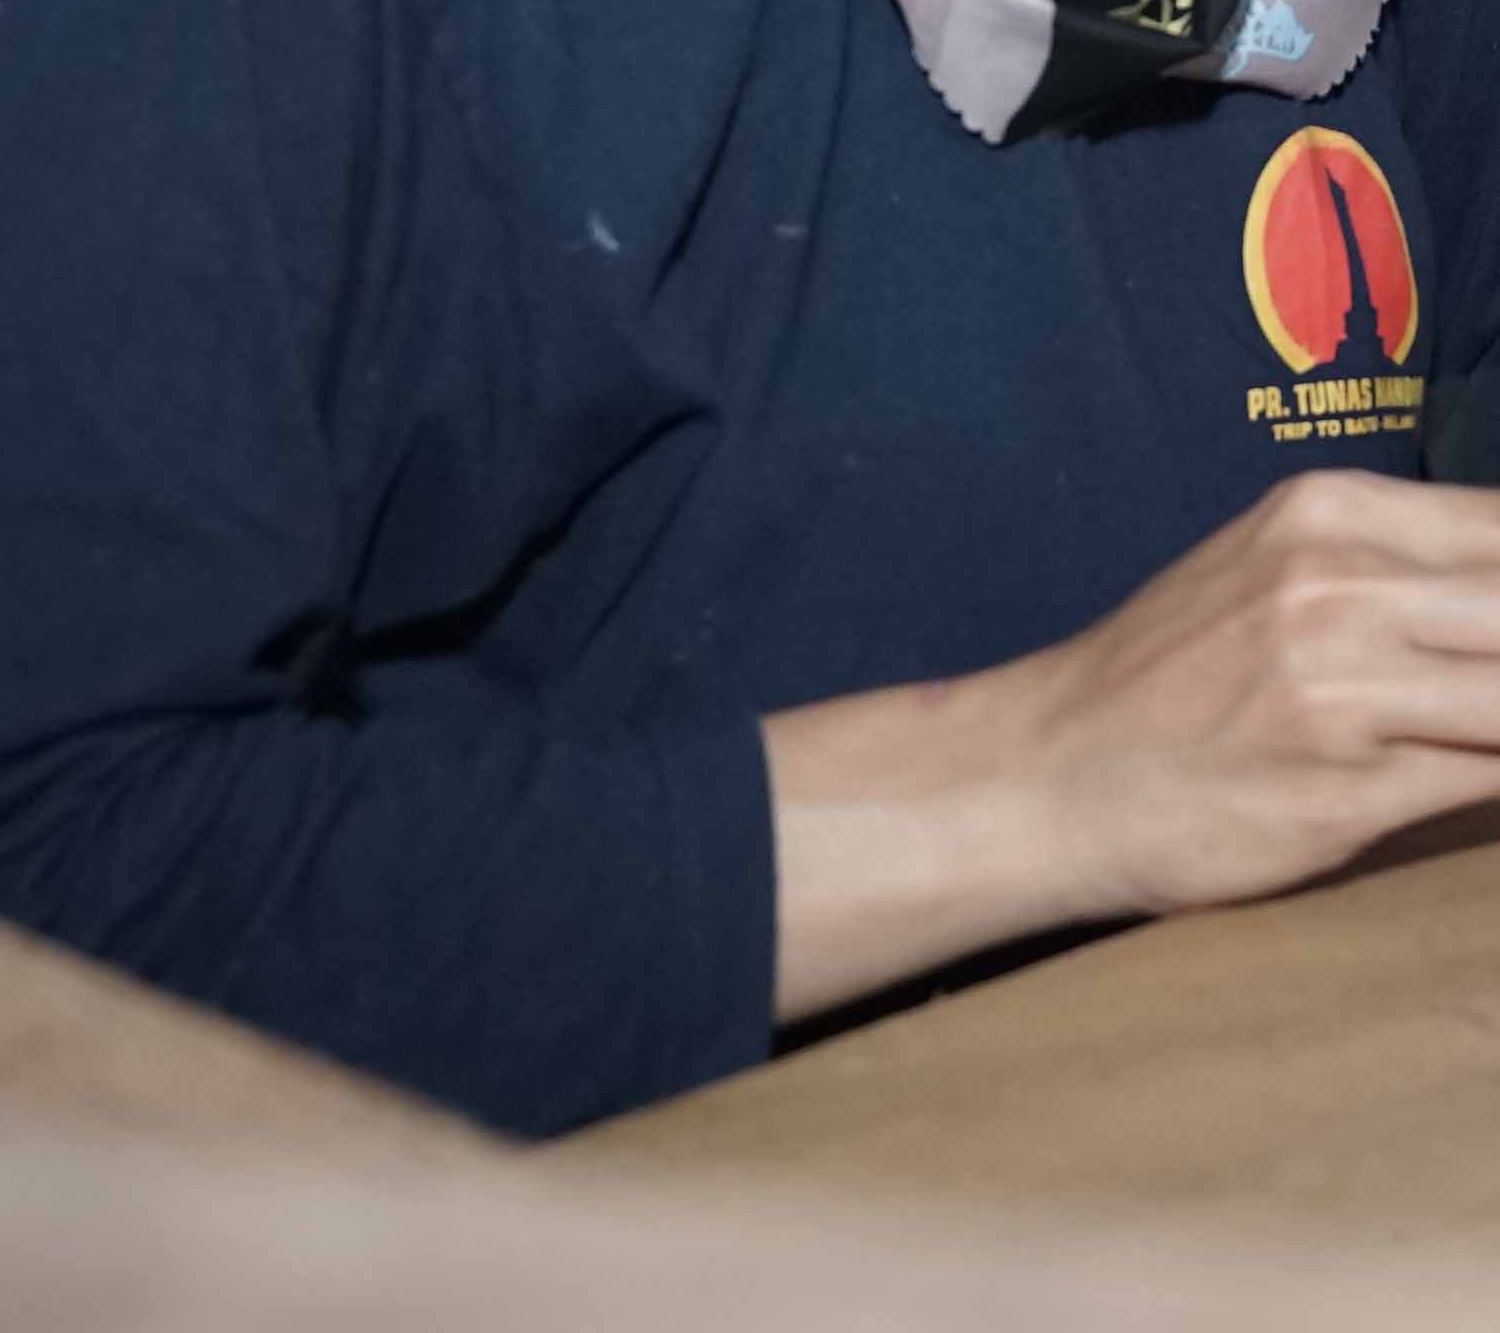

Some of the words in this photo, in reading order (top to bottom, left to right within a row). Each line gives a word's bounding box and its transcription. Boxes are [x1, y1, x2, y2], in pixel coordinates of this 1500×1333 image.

[1246, 386, 1291, 421] PR.
[1293, 378, 1373, 415] TUNAS
[1315, 419, 1341, 437] TO
